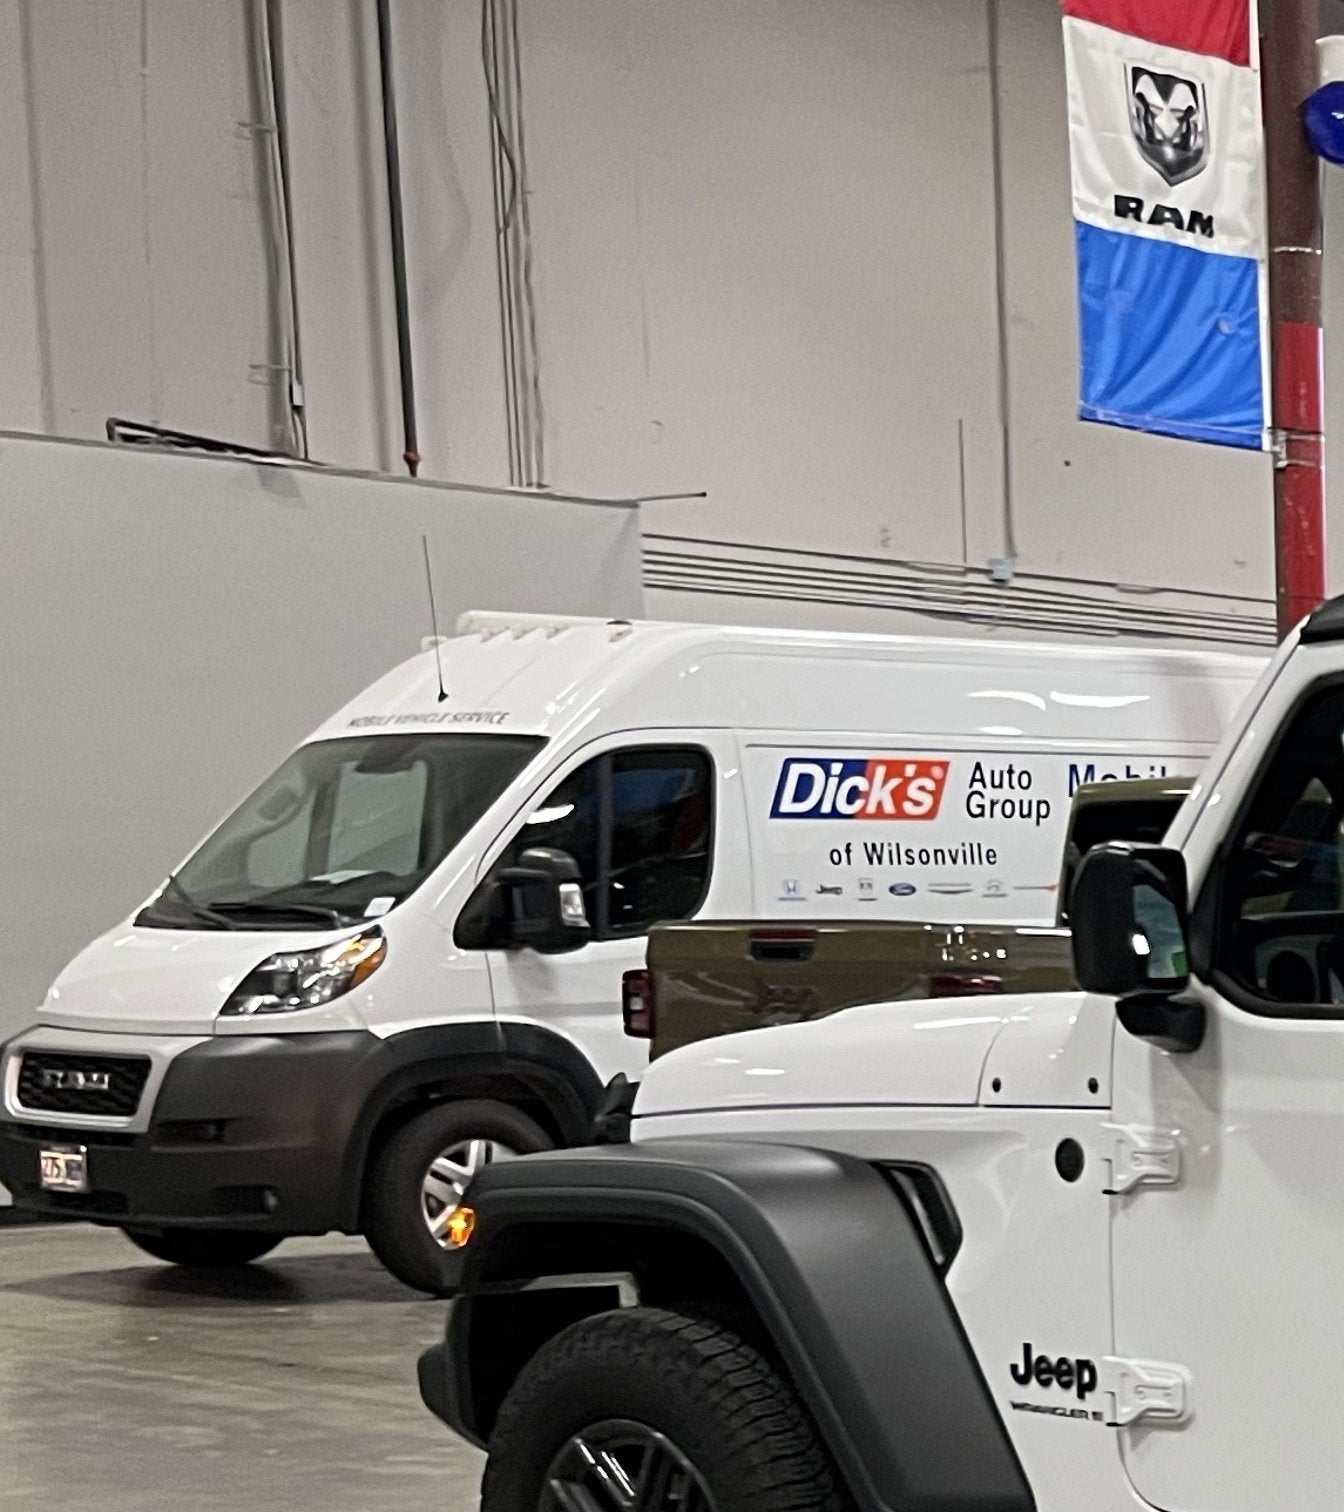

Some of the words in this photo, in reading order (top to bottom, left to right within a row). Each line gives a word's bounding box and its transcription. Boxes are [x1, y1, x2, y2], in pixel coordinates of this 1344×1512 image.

[1113, 194, 1215, 238] RAM
[778, 762, 937, 816] Dick's
[968, 761, 1032, 791] Auto
[966, 791, 1051, 826] Group
[829, 843, 853, 866] of
[863, 842, 998, 866] Wilsonville
[1009, 1342, 1098, 1401] Jeep
